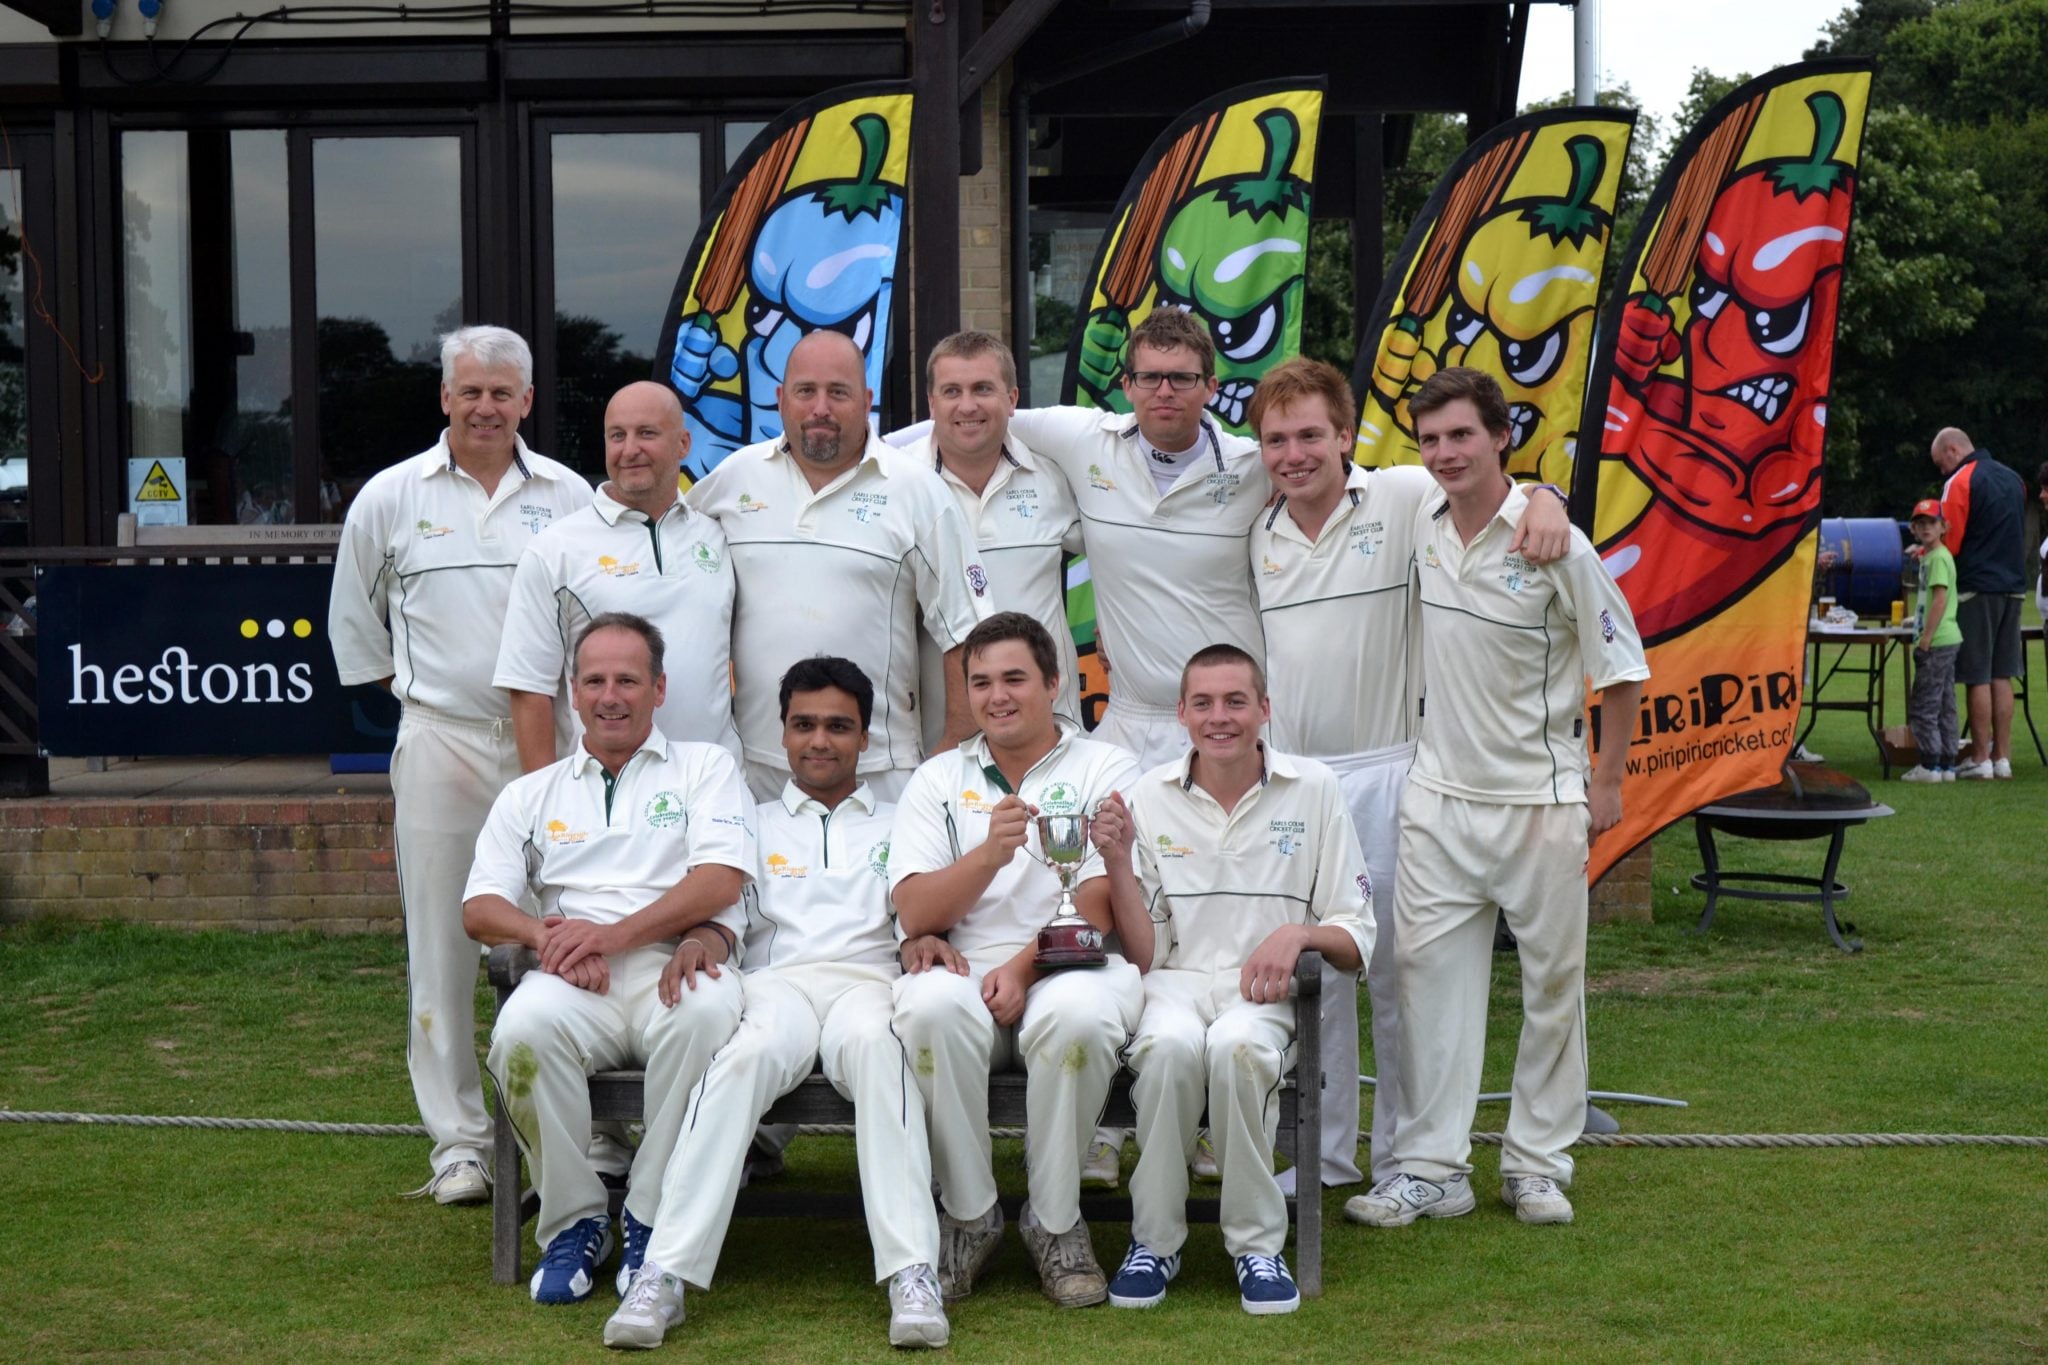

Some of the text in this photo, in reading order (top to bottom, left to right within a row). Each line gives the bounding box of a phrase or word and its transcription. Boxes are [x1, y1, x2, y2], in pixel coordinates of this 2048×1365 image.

[147, 490, 168, 498] CCTV
[249, 529, 260, 539] IN
[264, 529, 308, 539] MEMORY
[313, 529, 326, 538] OF
[67, 643, 313, 704] hestons
[1408, 1184, 1429, 1201] N
